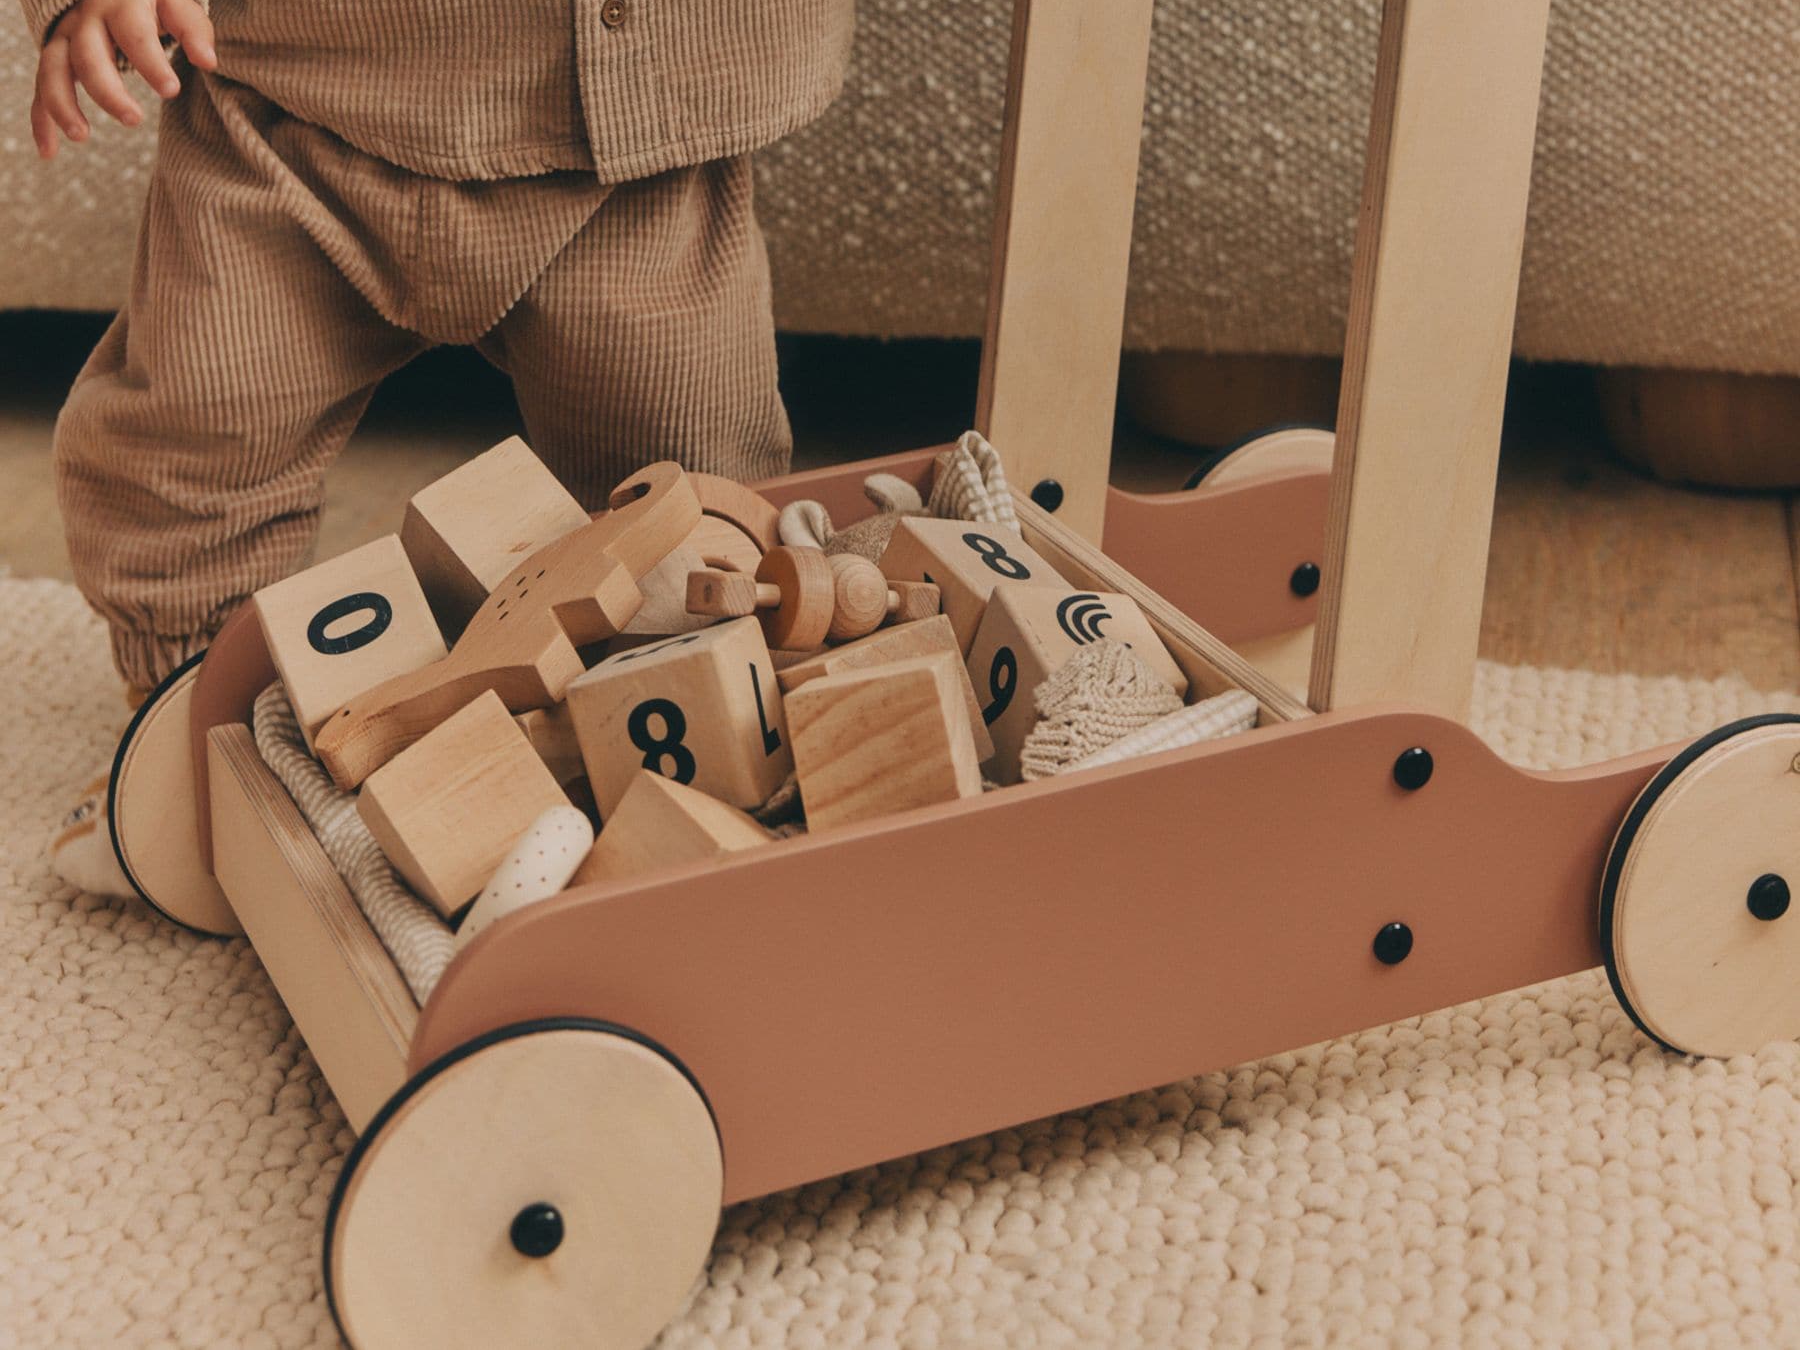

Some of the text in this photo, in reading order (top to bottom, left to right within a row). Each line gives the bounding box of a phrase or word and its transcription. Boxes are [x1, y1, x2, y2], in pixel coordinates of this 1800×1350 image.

[962, 533, 1031, 580] 8
[307, 592, 393, 655] 0
[627, 698, 696, 786] 8
